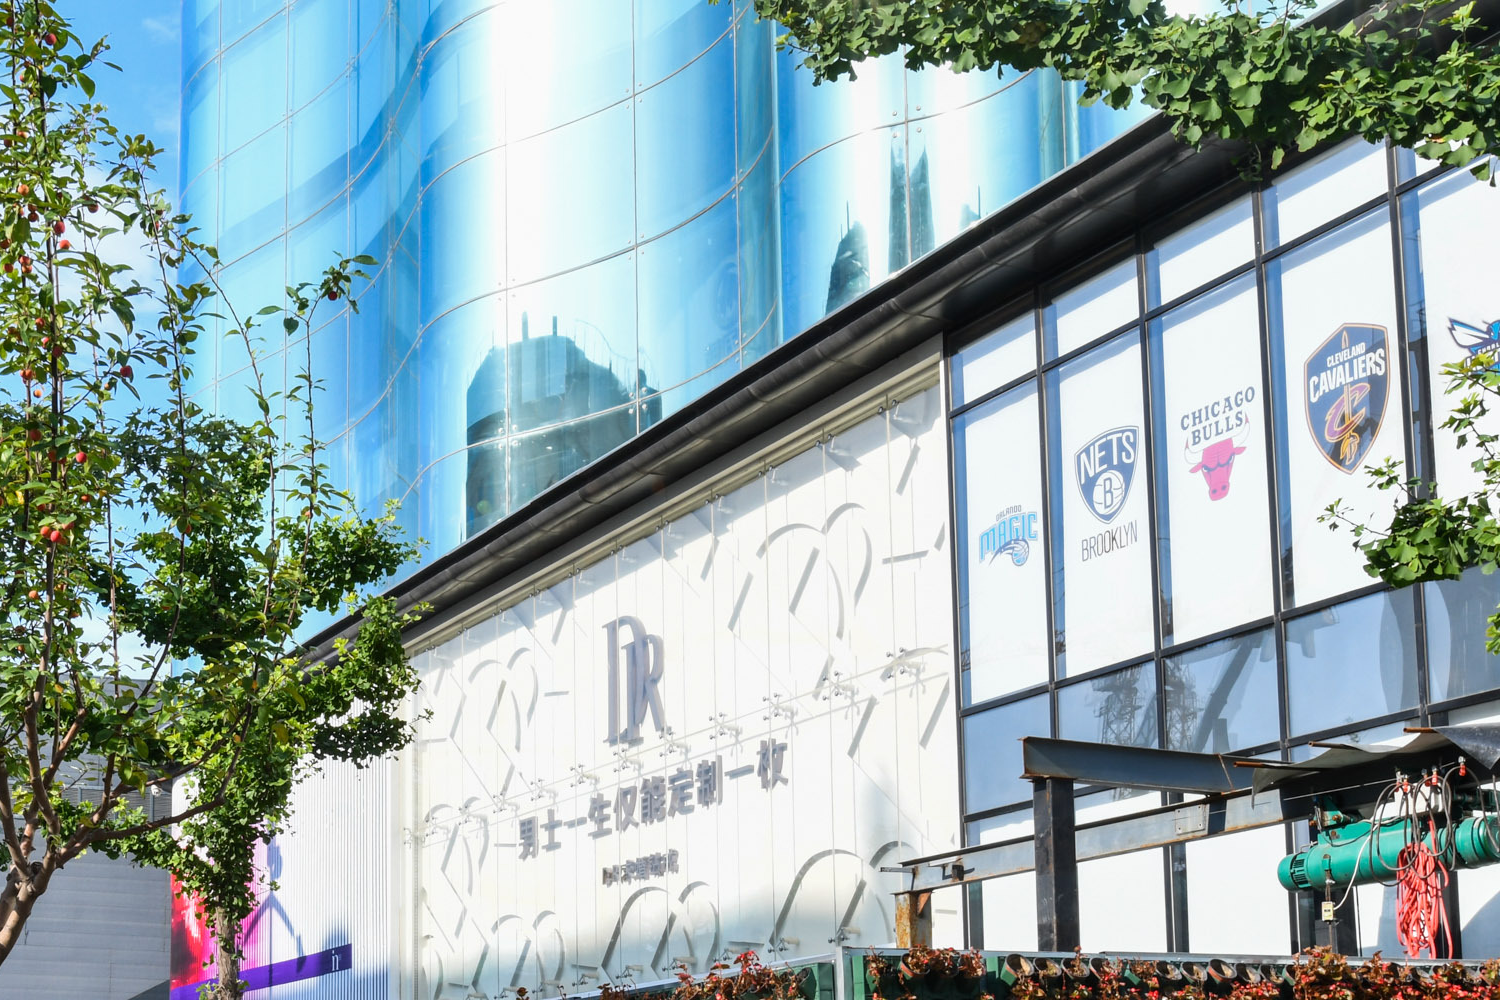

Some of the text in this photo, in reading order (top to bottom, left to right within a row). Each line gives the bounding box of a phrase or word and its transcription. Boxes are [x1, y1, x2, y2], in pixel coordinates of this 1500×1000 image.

[1309, 348, 1386, 403] CAVALIERS
[1326, 341, 1367, 368] CLEVELAND
[1180, 386, 1256, 431] CHICAGO
[1190, 410, 1244, 446] BULLS
[1079, 431, 1135, 485] NETS
[995, 504, 1022, 522] ORLANDO
[979, 511, 1038, 564] MAGIC
[1081, 519, 1138, 562] BROOKLYN
